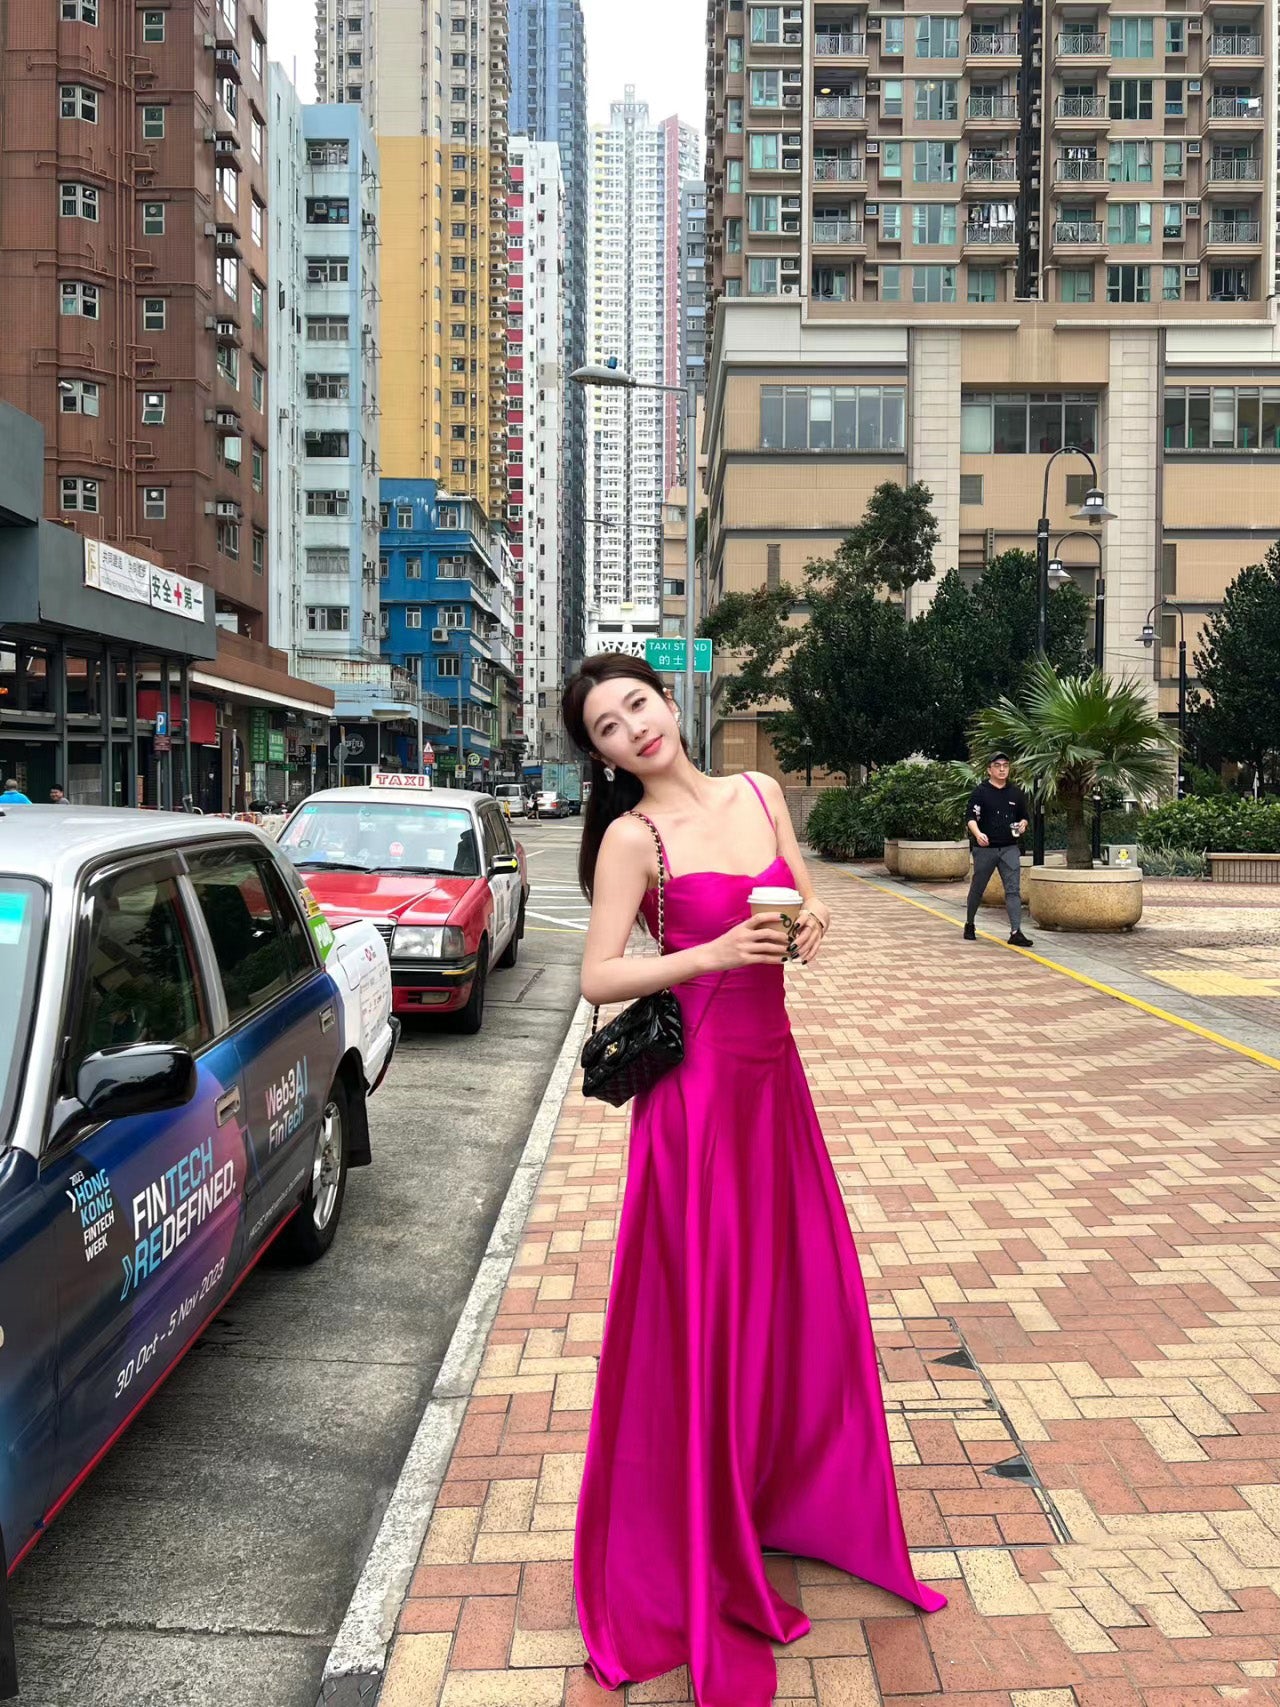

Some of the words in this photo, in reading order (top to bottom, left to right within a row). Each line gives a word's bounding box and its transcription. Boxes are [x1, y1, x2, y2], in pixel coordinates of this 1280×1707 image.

[649, 642, 671, 650] TAXI
[673, 642, 707, 651] STND
[658, 655, 697, 666] 的士
[156, 714, 165, 732] P
[376, 774, 425, 787] TAXI
[268, 1098, 304, 1155] FinTech
[74, 1168, 110, 1206] HONG
[132, 1136, 214, 1241] FINTECH
[80, 1188, 113, 1228] KONG
[133, 1159, 236, 1289] REDEFINED.
[83, 1210, 115, 1246] FINTECH
[85, 1233, 108, 1263] WEEK
[115, 1359, 135, 1399] 30
[136, 1332, 159, 1374] Oct
[168, 1309, 178, 1337] 5
[178, 1290, 199, 1326] Nov
[199, 1256, 225, 1301] 2023
